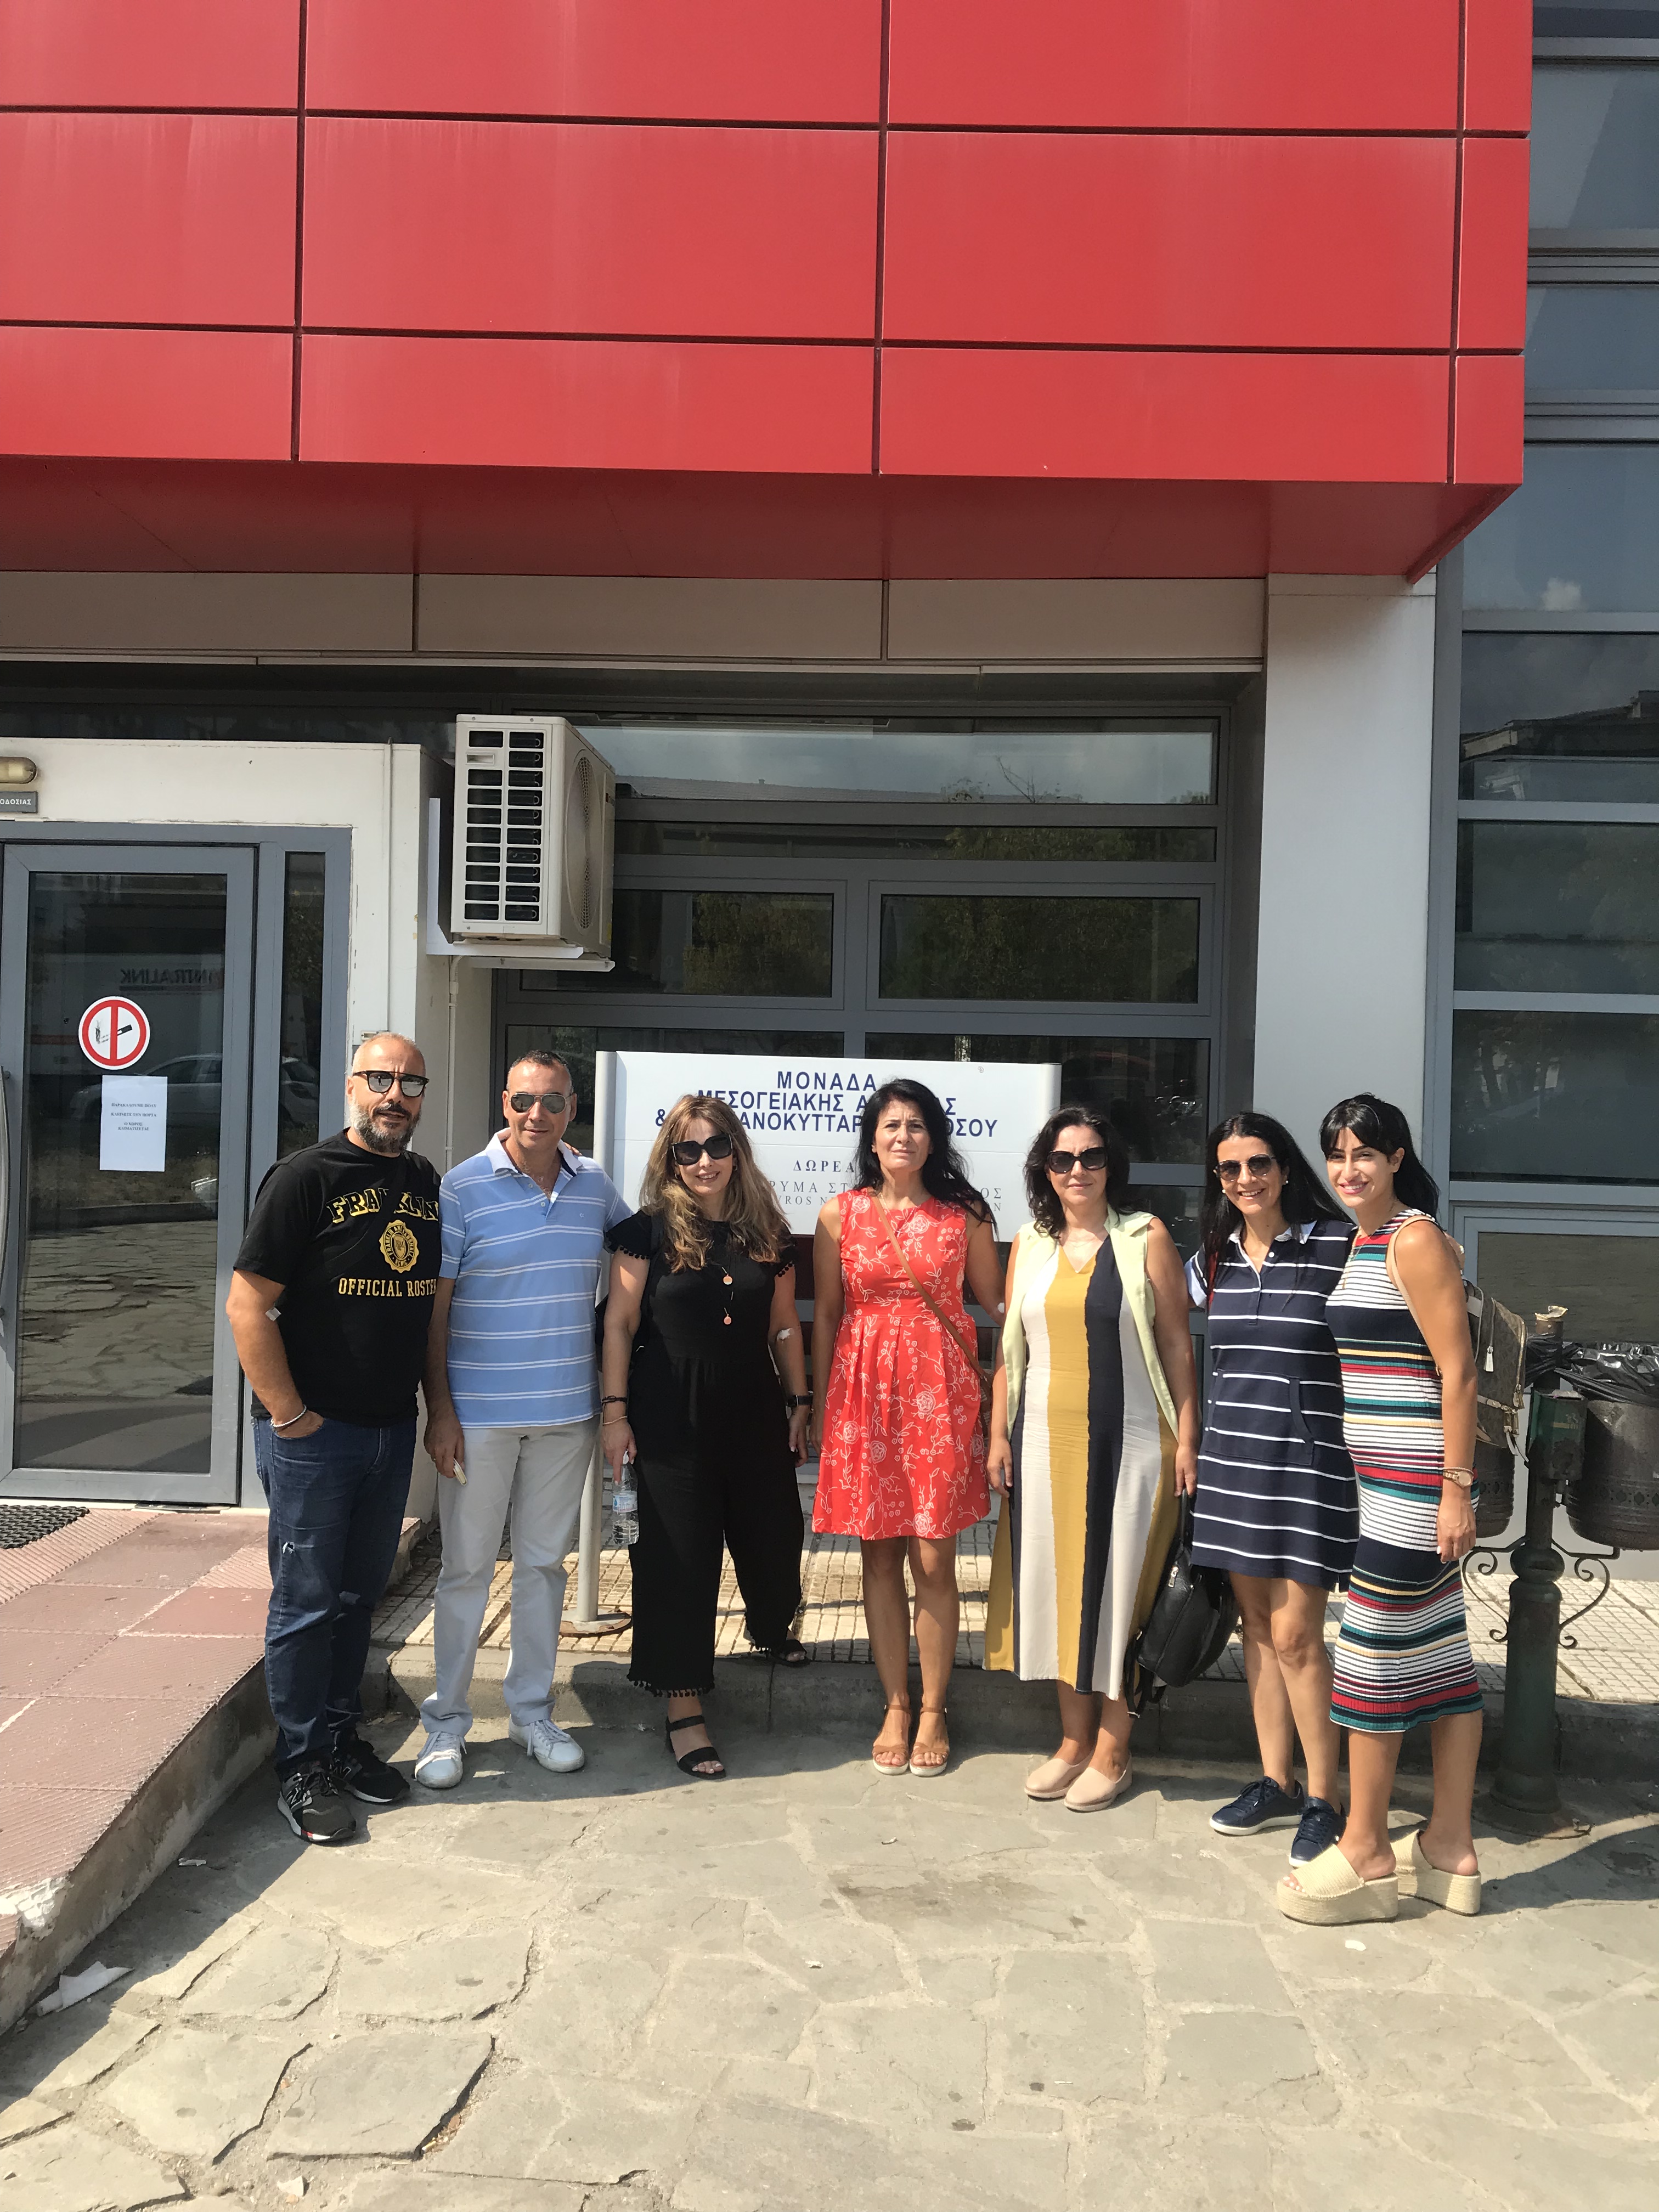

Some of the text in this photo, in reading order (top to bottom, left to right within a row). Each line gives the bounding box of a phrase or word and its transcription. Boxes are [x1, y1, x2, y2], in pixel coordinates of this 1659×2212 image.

[777, 1071, 877, 1091] ΜΟΝΑΔΑ
[655, 1109, 665, 1126] &
[793, 1160, 855, 1173] ΔΩΡΕΑ
[338, 1278, 403, 1297] OFFICIAL
